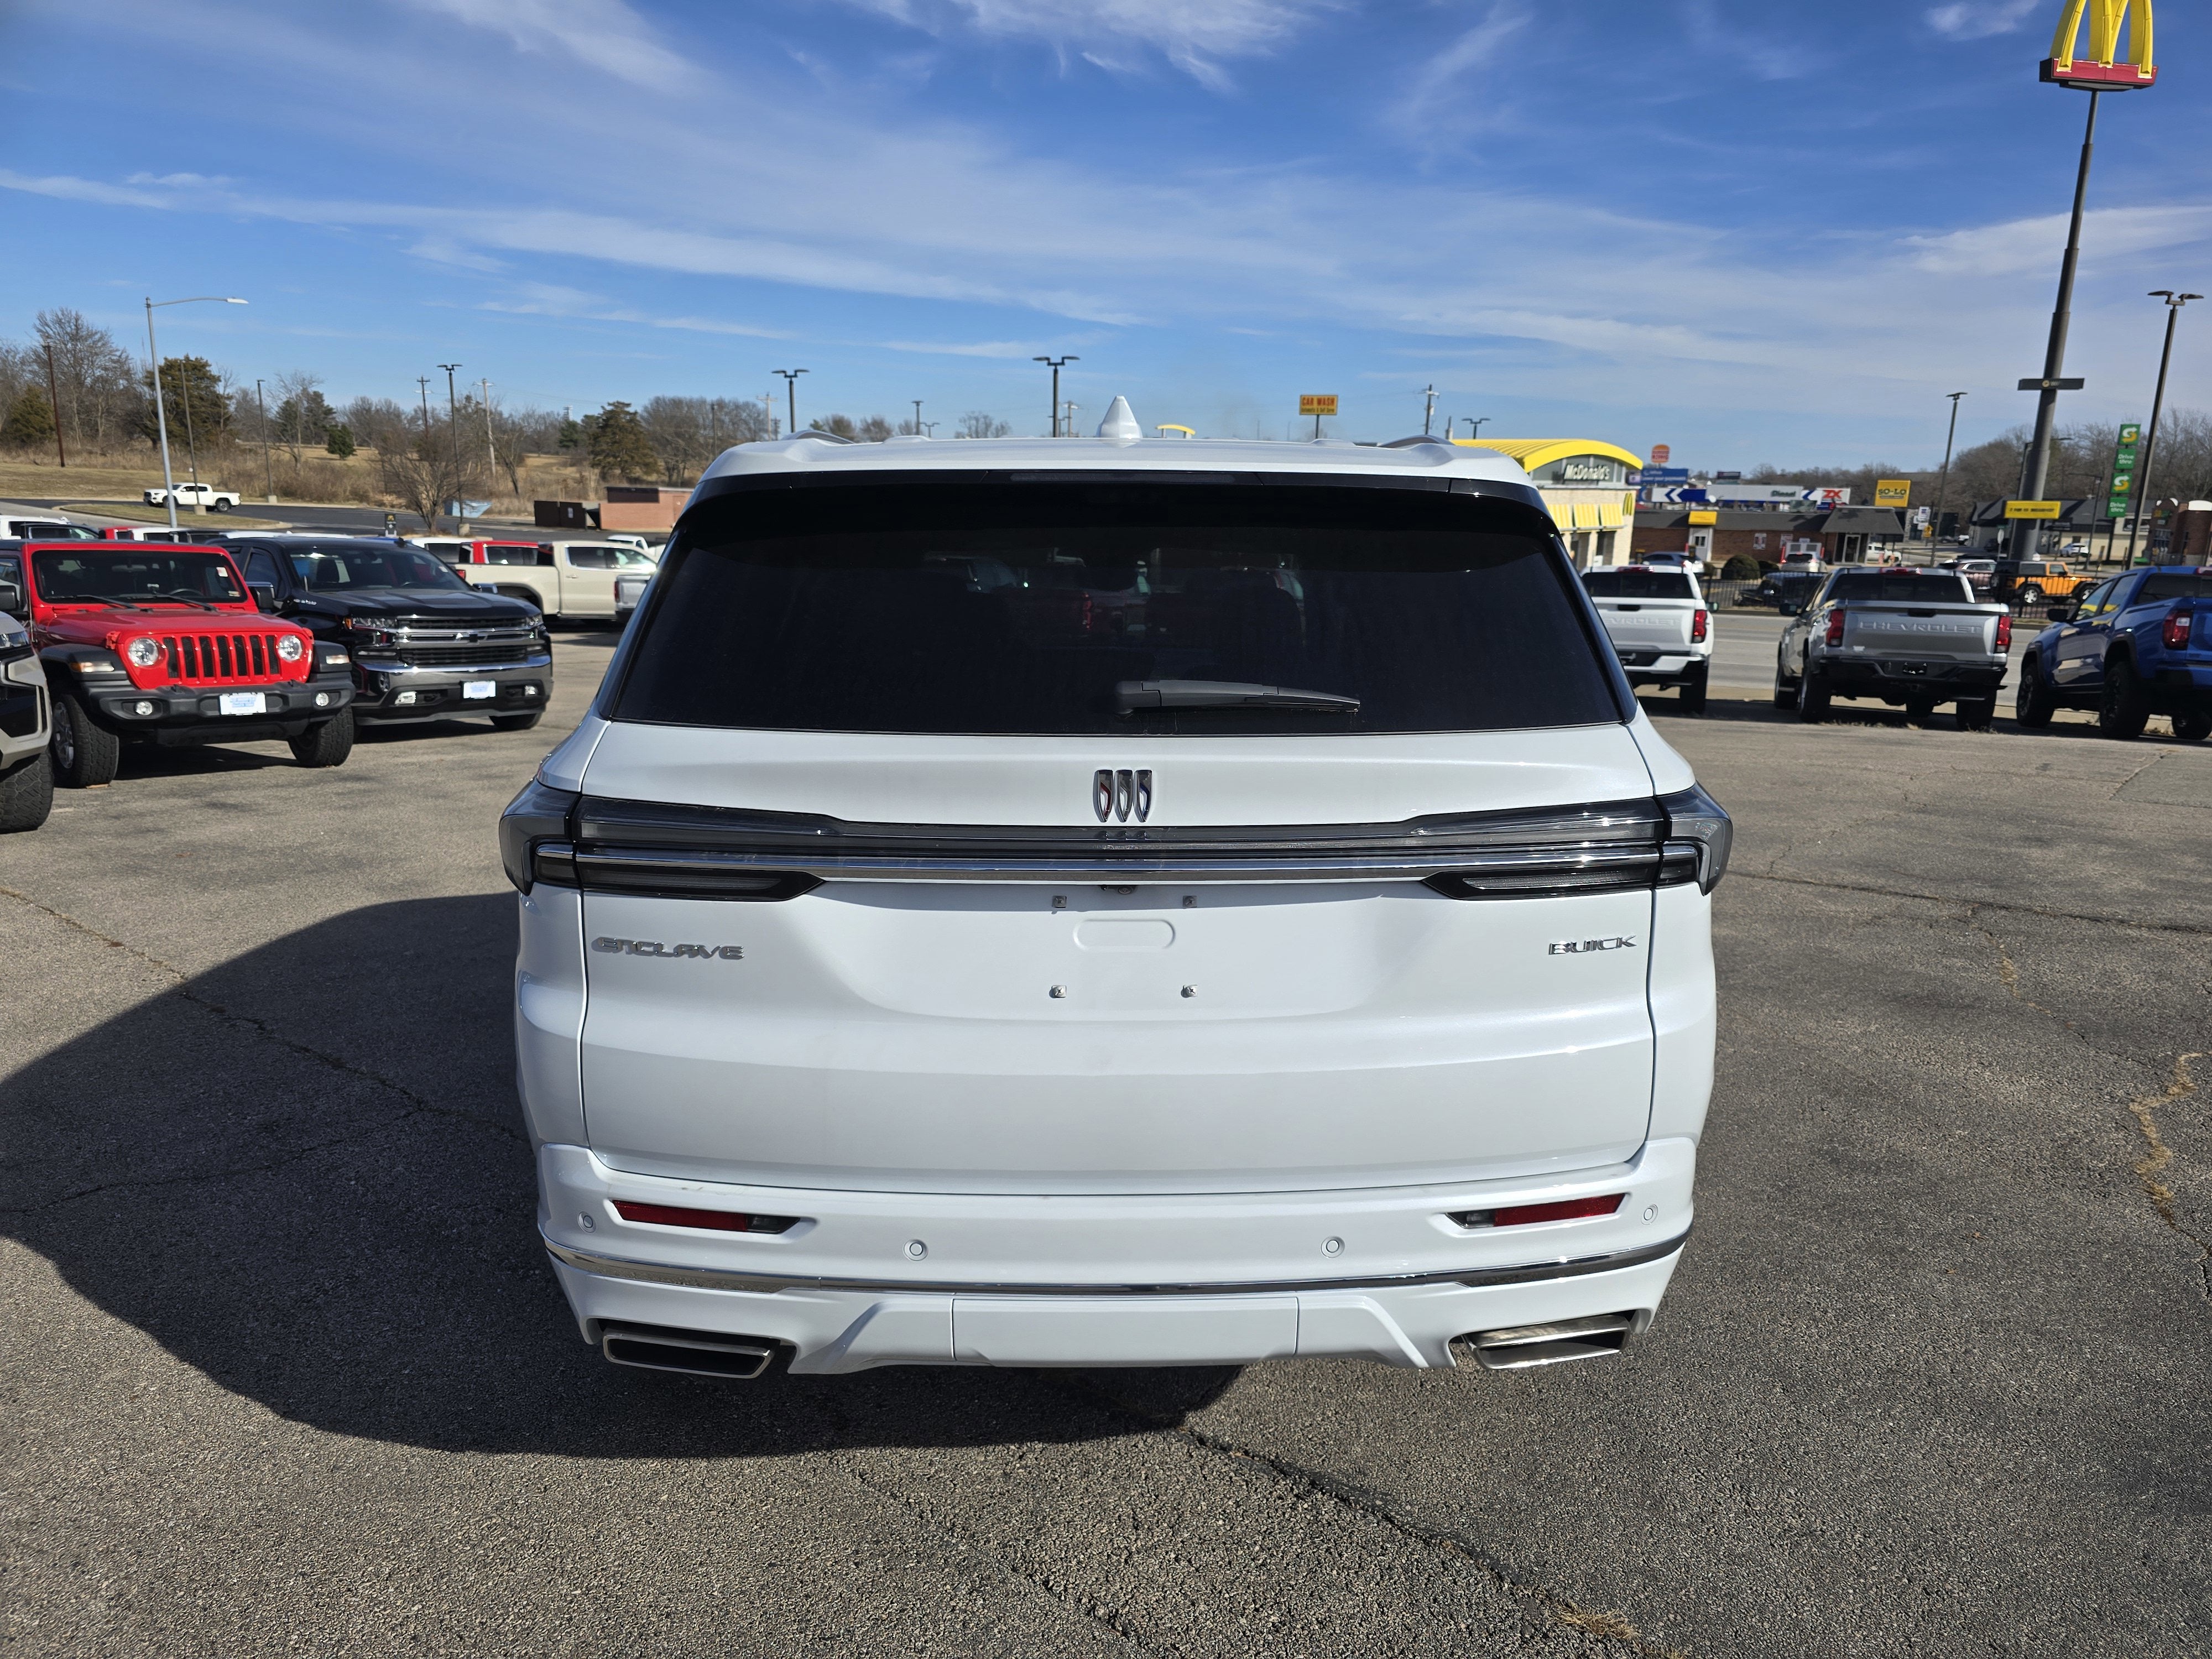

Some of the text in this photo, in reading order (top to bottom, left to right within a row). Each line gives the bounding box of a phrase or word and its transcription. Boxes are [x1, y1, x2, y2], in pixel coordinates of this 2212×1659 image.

[1302, 397, 1335, 406] CAR WASH
[1564, 463, 1610, 480] McDonald's
[1604, 617, 1681, 627] EVROLET
[1859, 620, 1983, 634] CHEVROLET
[591, 936, 745, 960] ENCLAVE
[1548, 934, 1637, 955] BUICK
